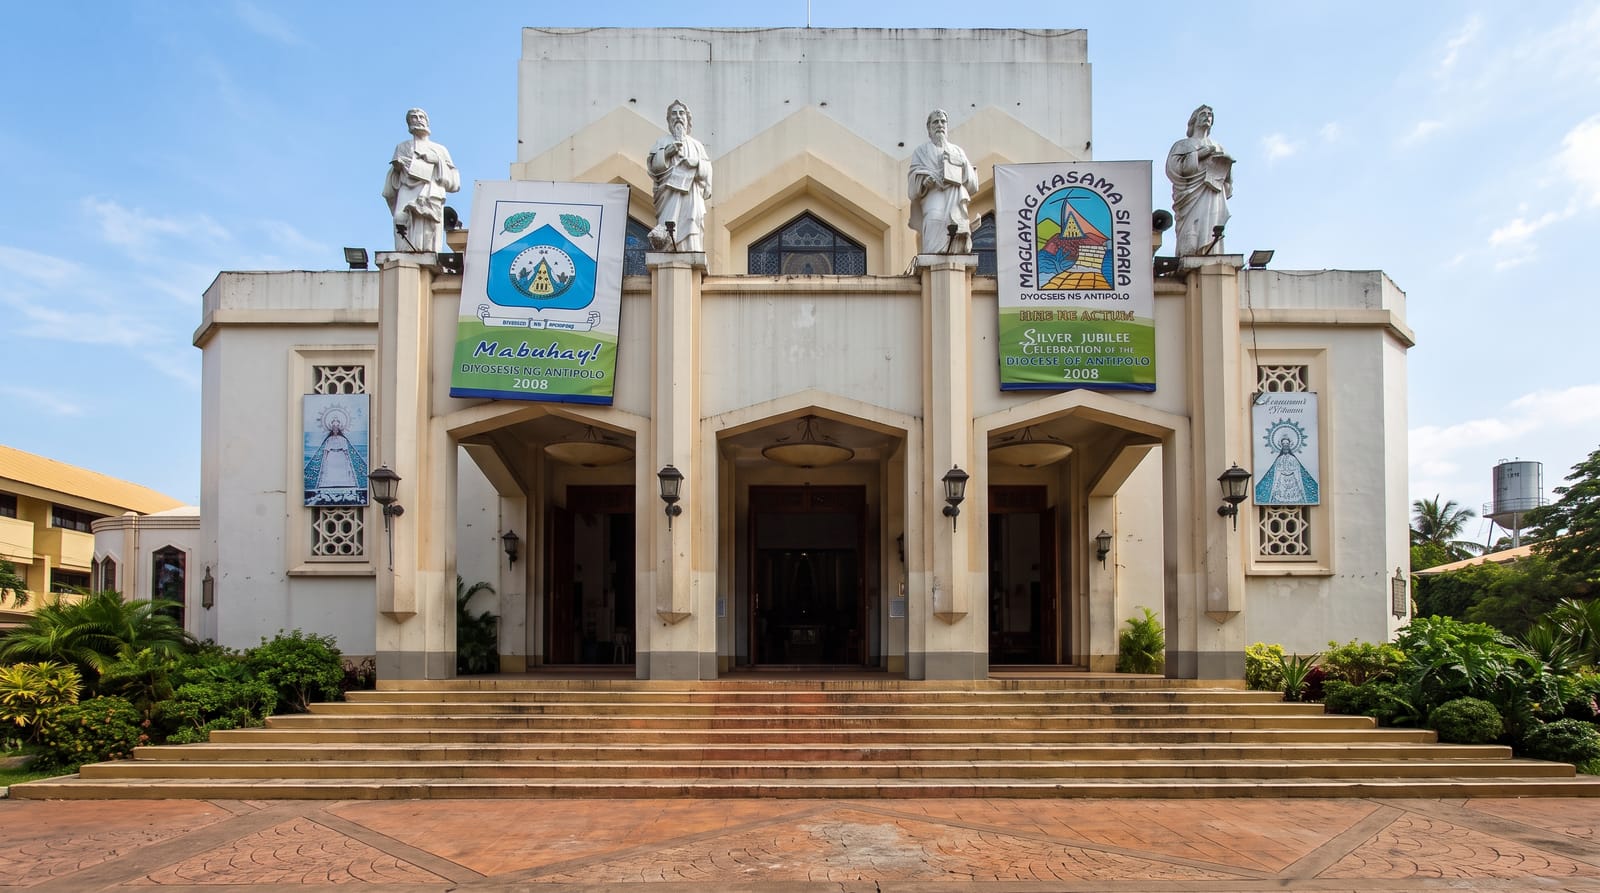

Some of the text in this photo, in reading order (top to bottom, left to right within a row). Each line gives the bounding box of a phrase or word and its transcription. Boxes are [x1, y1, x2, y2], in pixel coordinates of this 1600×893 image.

[1018, 171, 1131, 288] MAGLAYAG KASAMA SI MARIA
[1080, 333, 1131, 344] JUBILEE
[473, 340, 602, 366] Mabuhay!
[1022, 344, 1101, 355] CELEBRATION
[1105, 346, 1115, 354] OF
[1006, 356, 1150, 367] DIOCESE OF ANTIPOLO
[461, 363, 605, 380] DIYOSESIS NG ANTIPOLO
[1063, 368, 1100, 379] 2008
[512, 378, 548, 390] 2008
